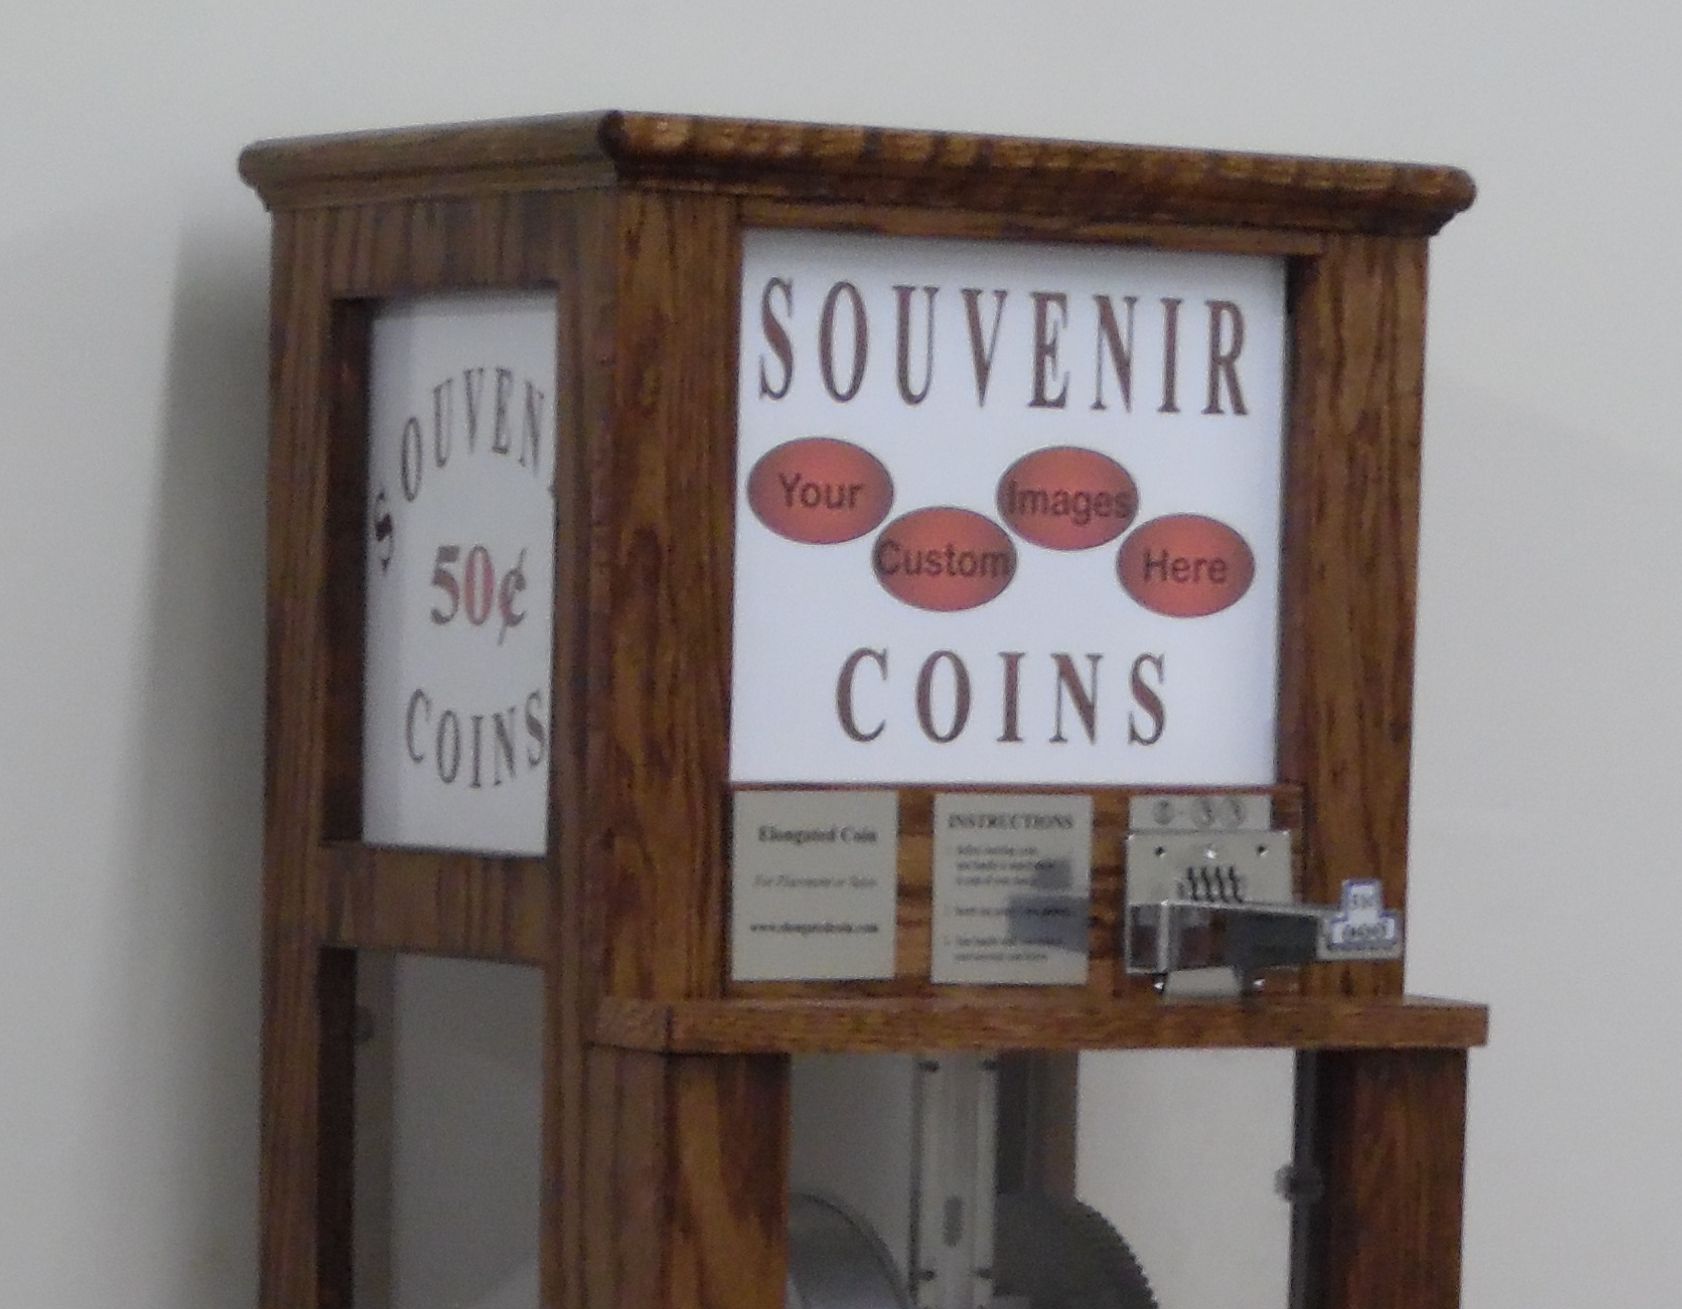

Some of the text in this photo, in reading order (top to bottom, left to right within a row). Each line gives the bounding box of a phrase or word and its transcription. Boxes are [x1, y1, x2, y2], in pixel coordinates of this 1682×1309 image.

[758, 275, 1249, 416] SOUVENIR
[779, 472, 864, 509] Your
[1008, 479, 1132, 528] Images
[875, 540, 1013, 578] Custom
[1142, 549, 1228, 585] Here
[430, 545, 527, 646] 50¢
[835, 647, 1167, 747] COINS
[405, 688, 546, 788] COINS
[840, 825, 878, 843] Coin
[948, 813, 1074, 830] INSTRUCTIONS
